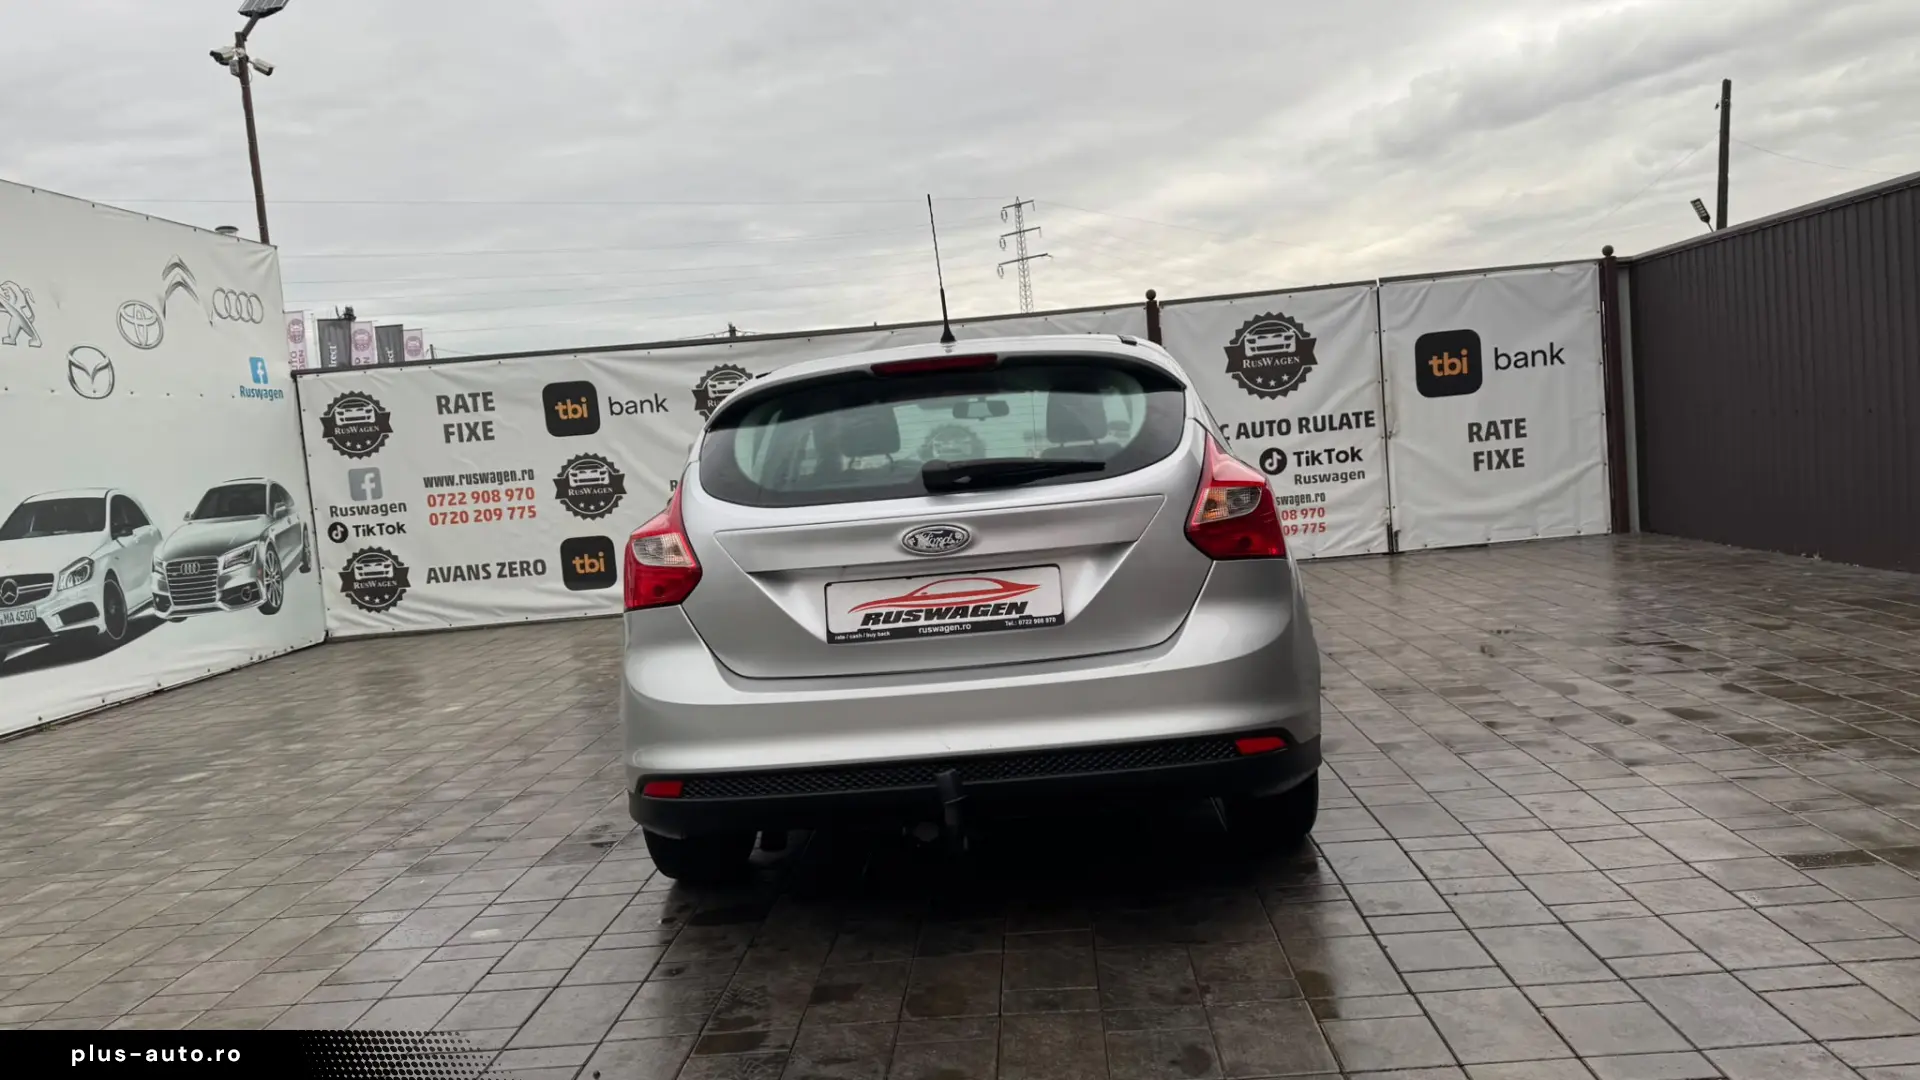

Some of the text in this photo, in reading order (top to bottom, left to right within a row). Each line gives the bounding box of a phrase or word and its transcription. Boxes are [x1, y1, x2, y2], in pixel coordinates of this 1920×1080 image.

[1428, 342, 1566, 377] tbi bank
[240, 385, 284, 401] Ruswagen
[436, 392, 496, 415] RATE
[555, 393, 669, 420] tbi bank
[443, 421, 495, 444] FIXE
[1236, 418, 1291, 440] AUTO
[1298, 410, 1376, 434] RULATE
[1467, 418, 1527, 443] RATE
[1293, 446, 1364, 467] TikTok
[1473, 448, 1525, 472] FIXE
[423, 469, 535, 489] www.ruswagen.ro
[1294, 470, 1366, 485] Ruswagen
[427, 487, 535, 508] 0722 908 970
[329, 502, 407, 518] Ruswagen
[429, 505, 537, 527] 0720 209 775
[1301, 507, 1326, 518] 970
[352, 521, 407, 538] TikTok
[1302, 522, 1327, 534] 775
[426, 559, 547, 584] AVANS ZERO
[572, 551, 606, 575] tbi
[860, 601, 1028, 626] RUSWAGEN
[918, 624, 972, 635] ruswagen.ro
